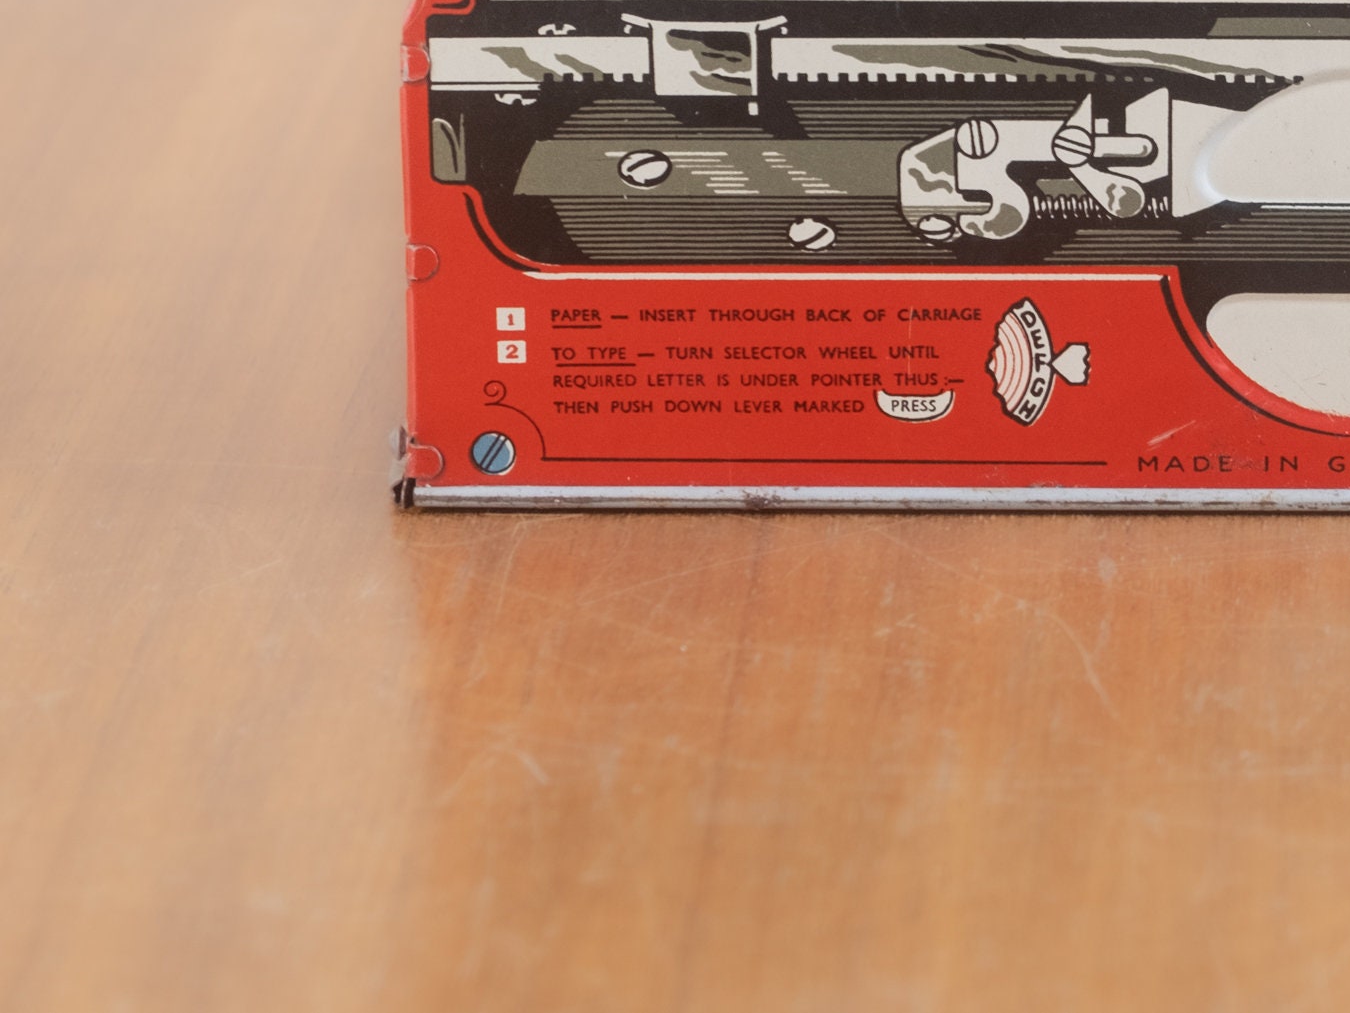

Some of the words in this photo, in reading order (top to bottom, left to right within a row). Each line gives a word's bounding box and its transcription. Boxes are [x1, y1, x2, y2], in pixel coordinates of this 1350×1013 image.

[507, 313, 515, 326] 1
[550, 308, 602, 323] PAPER
[639, 308, 697, 323] INSERT
[708, 308, 795, 323] THROUGH
[805, 308, 852, 323] BACK
[862, 308, 886, 323] OF
[896, 307, 982, 322] CARRIAGE
[505, 344, 519, 359] 2
[551, 346, 576, 361] TO
[587, 346, 627, 361] TYPE
[665, 346, 714, 361] TURN
[724, 346, 807, 361] SELECTOR
[818, 345, 878, 360] WHEEL
[888, 344, 940, 360] UNTIL
[552, 373, 637, 389] REQUIRED
[647, 373, 706, 388] LETTER
[716, 373, 730, 387] IS
[740, 373, 800, 387] UNDER
[810, 372, 882, 387] POINTER
[553, 400, 600, 415] THEN
[610, 399, 654, 414] PUSH
[664, 399, 722, 413] DOWN
[733, 399, 783, 414] LEVER
[793, 399, 865, 413] MARKED
[890, 399, 937, 413] PRESS
[1137, 454, 1233, 473] MADE
[1263, 455, 1299, 473] IN
